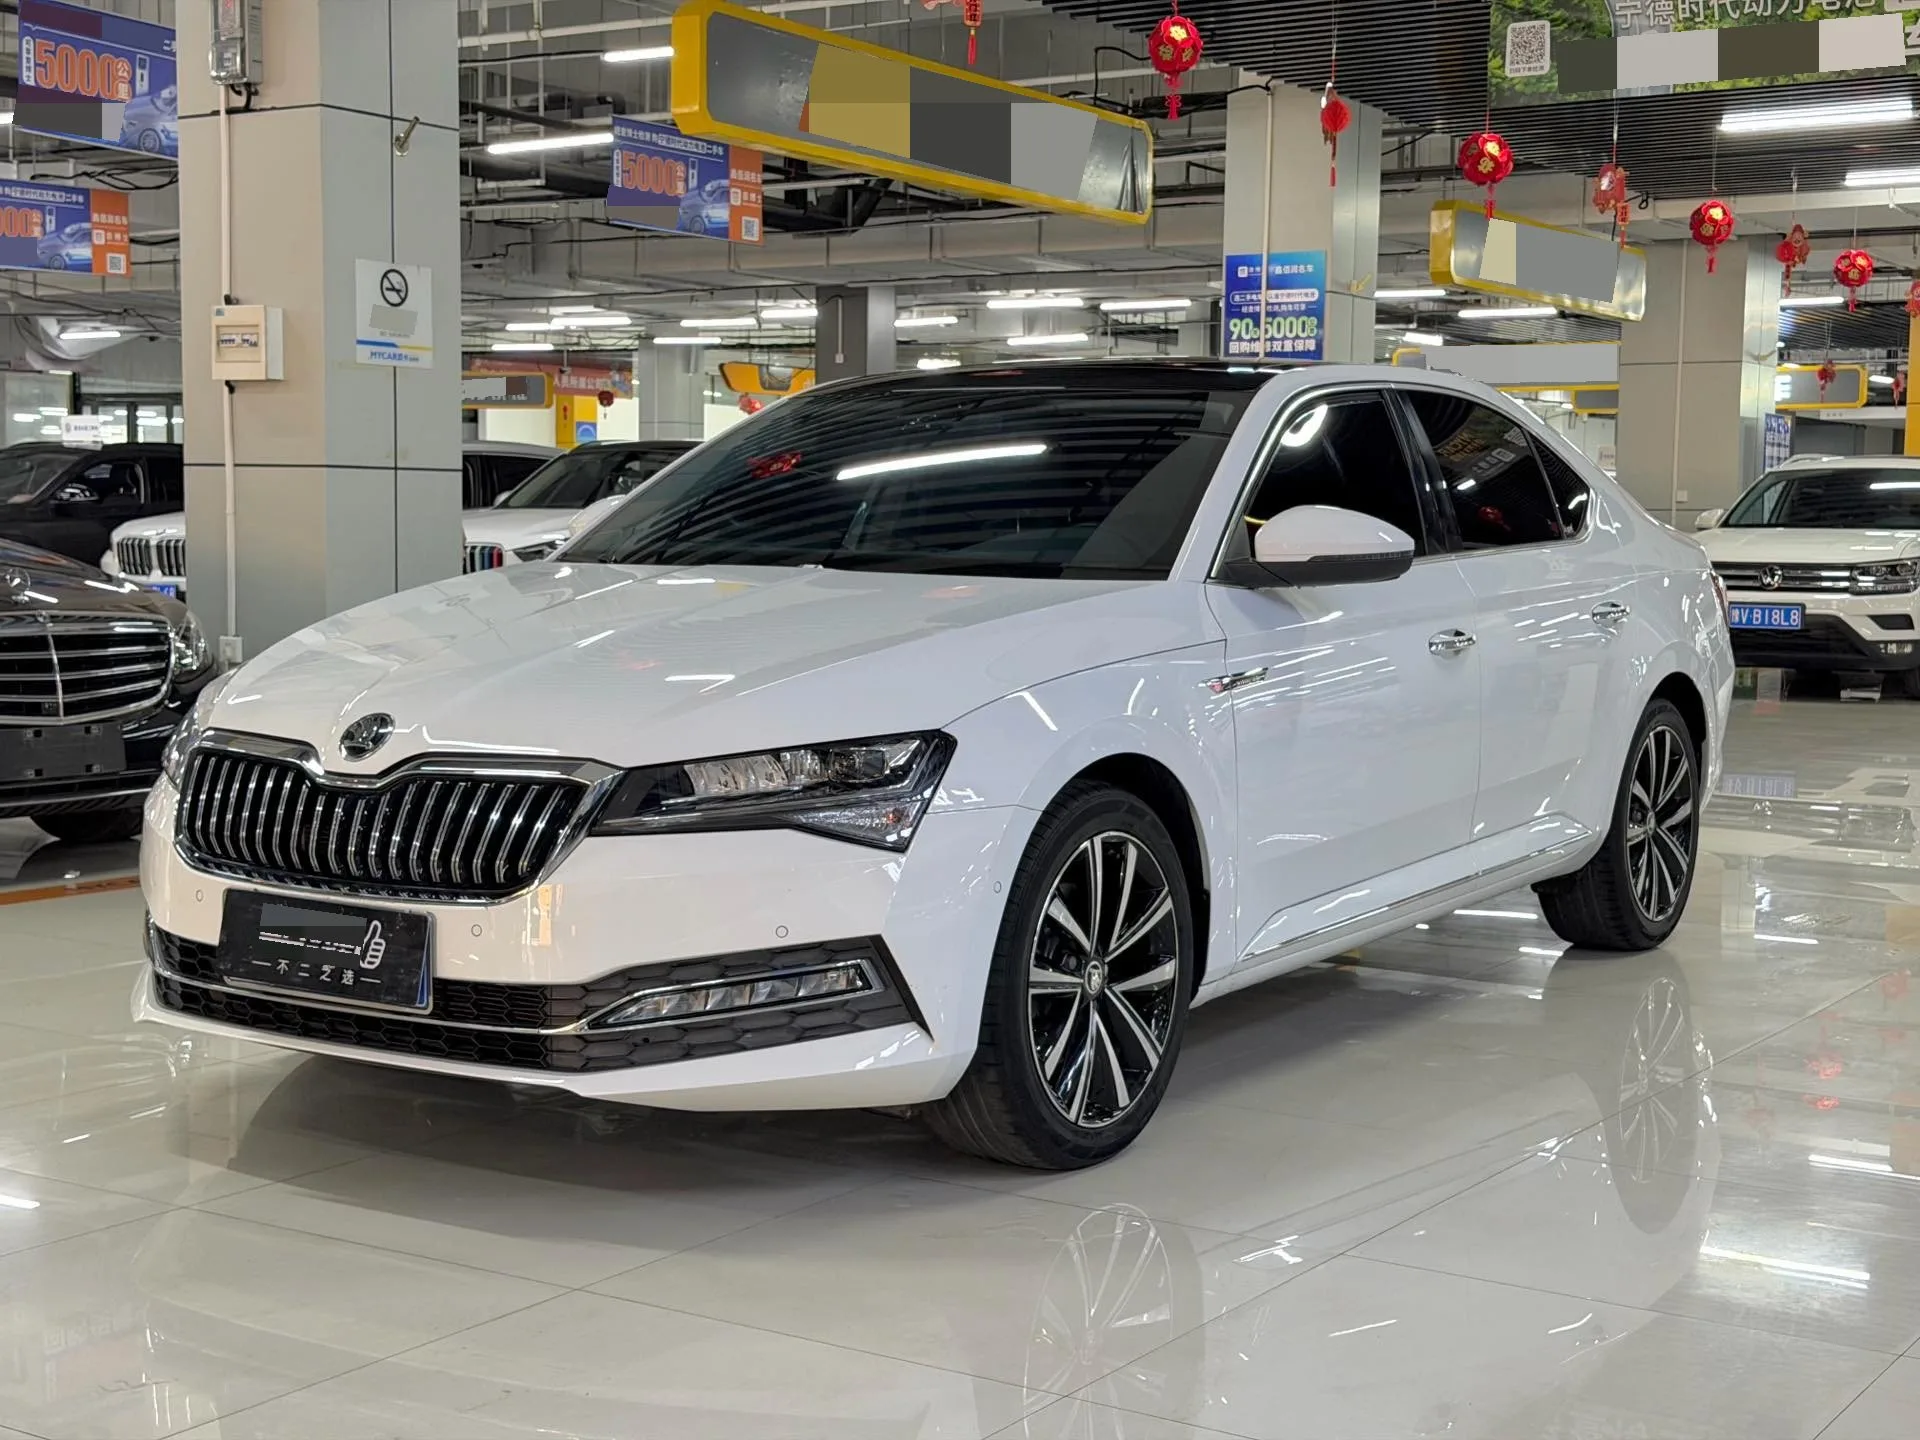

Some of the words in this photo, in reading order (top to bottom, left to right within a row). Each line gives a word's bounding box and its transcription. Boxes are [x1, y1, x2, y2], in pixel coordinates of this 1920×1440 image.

[1615, 0, 1874, 28] 宁德时代动力
[35, 39, 118, 99] 5000
[622, 152, 678, 195] 5000
[276, 959, 354, 985] 不二之选
